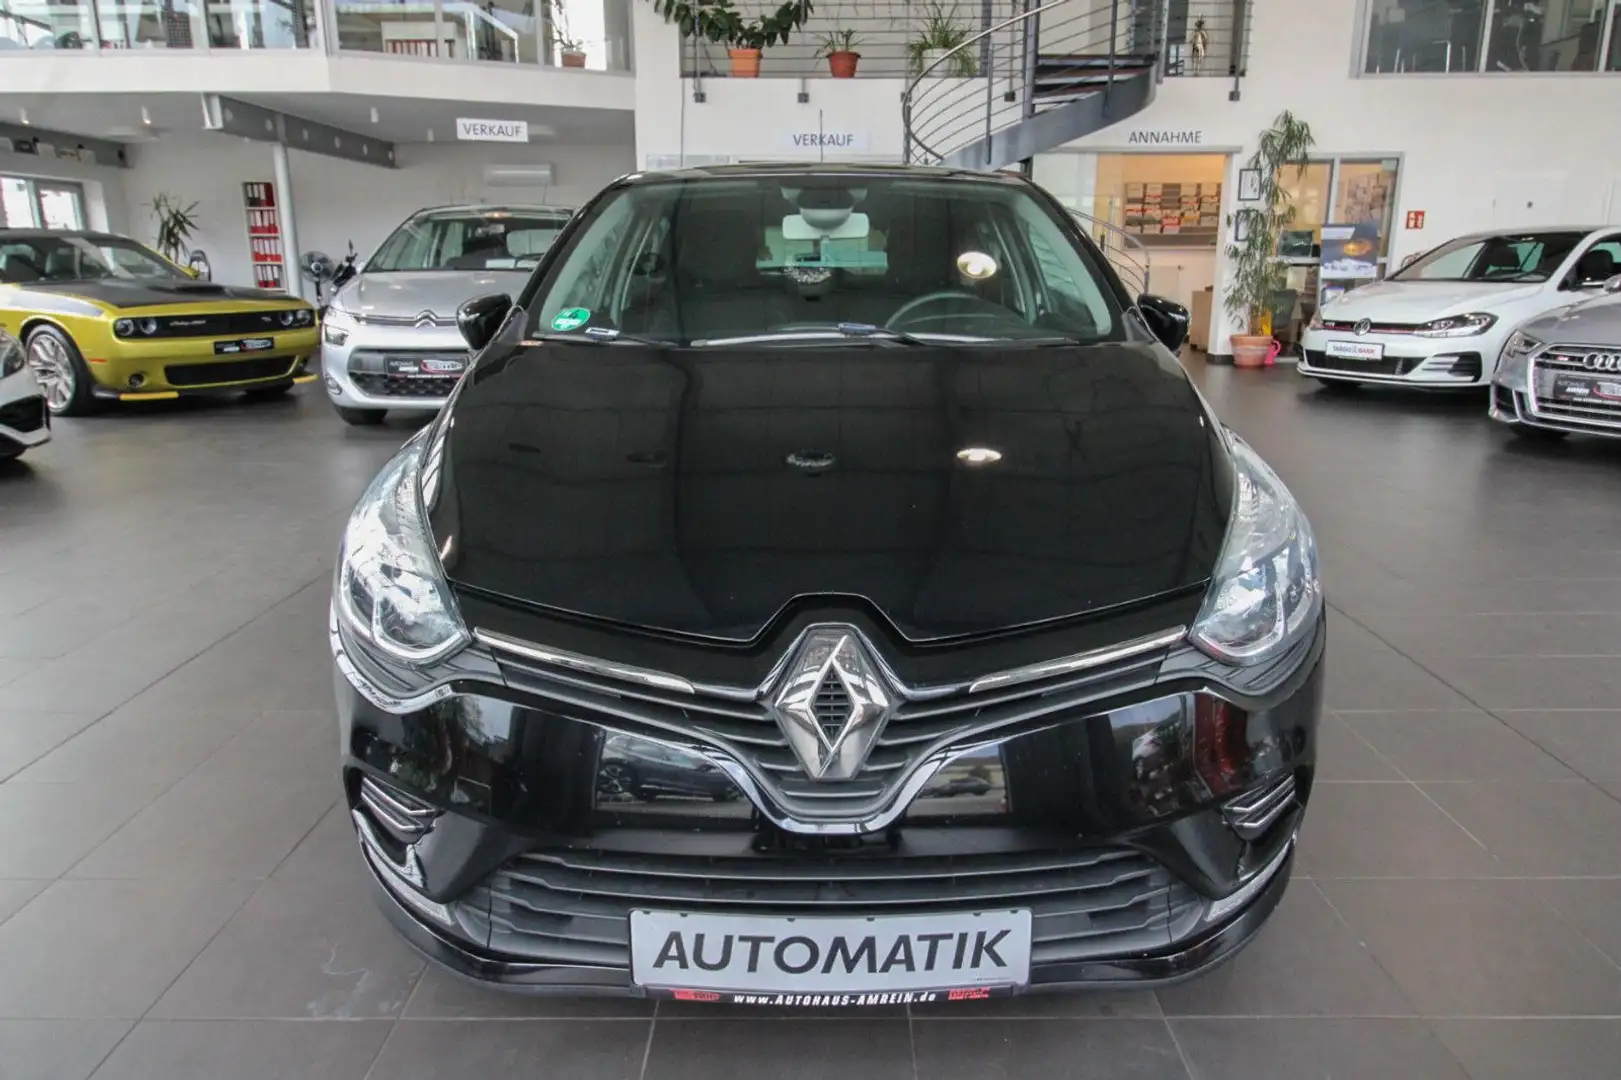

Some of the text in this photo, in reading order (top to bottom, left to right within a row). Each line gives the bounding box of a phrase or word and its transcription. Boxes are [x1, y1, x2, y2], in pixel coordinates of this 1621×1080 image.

[462, 123, 523, 138] VERKAUF
[1128, 130, 1202, 144] ANNAHME
[792, 133, 854, 146] VERKAUF
[653, 929, 1012, 974] AUTOMATIK
[733, 992, 937, 1007] www.AUTOHAUS-AMREIN.de
